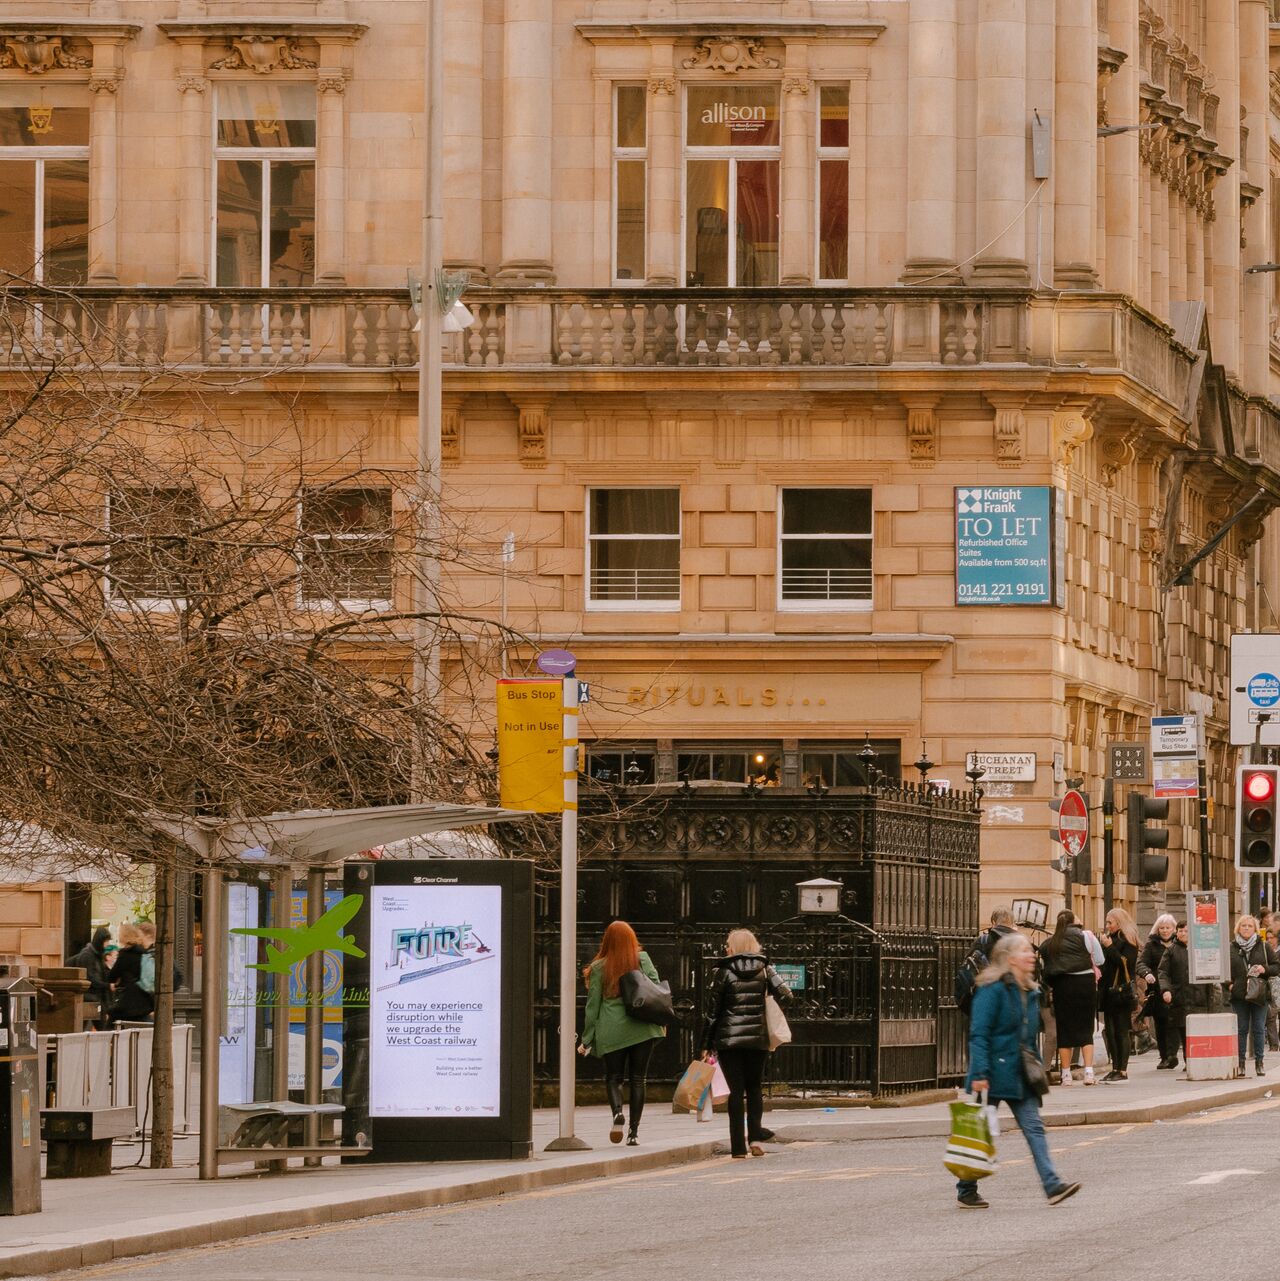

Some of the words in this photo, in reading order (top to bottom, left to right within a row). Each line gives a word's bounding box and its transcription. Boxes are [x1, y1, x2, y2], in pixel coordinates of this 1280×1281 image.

[701, 103, 766, 124] allison
[984, 489, 1022, 502] Knight
[984, 502, 1016, 513] Frank
[959, 518, 992, 536] TO
[1002, 518, 1041, 536] LET
[959, 539, 1003, 547] Refurbished
[1005, 538, 1028, 546] Office
[959, 559, 992, 567] Available
[959, 583, 988, 596] 0141
[991, 584, 1013, 595] 221
[1016, 583, 1045, 595] 9191
[508, 691, 527, 699] Bus
[531, 690, 556, 700] Stop
[505, 723, 523, 731] Not
[527, 722, 536, 731] in
[540, 722, 559, 730] Use
[970, 755, 1031, 764] BUCHANAN
[980, 765, 1024, 774] STREET
[390, 924, 476, 967] FUTURE
[387, 1001, 404, 1010] You
[407, 1003, 428, 1011] may
[430, 1001, 483, 1011] experience
[387, 1013, 435, 1023] disruption
[438, 1013, 463, 1021] while
[403, 1024, 442, 1035] upgrade
[445, 1024, 461, 1032] the
[387, 1036, 411, 1045] West
[414, 1036, 441, 1045] Coast
[444, 1036, 477, 1046] railway
